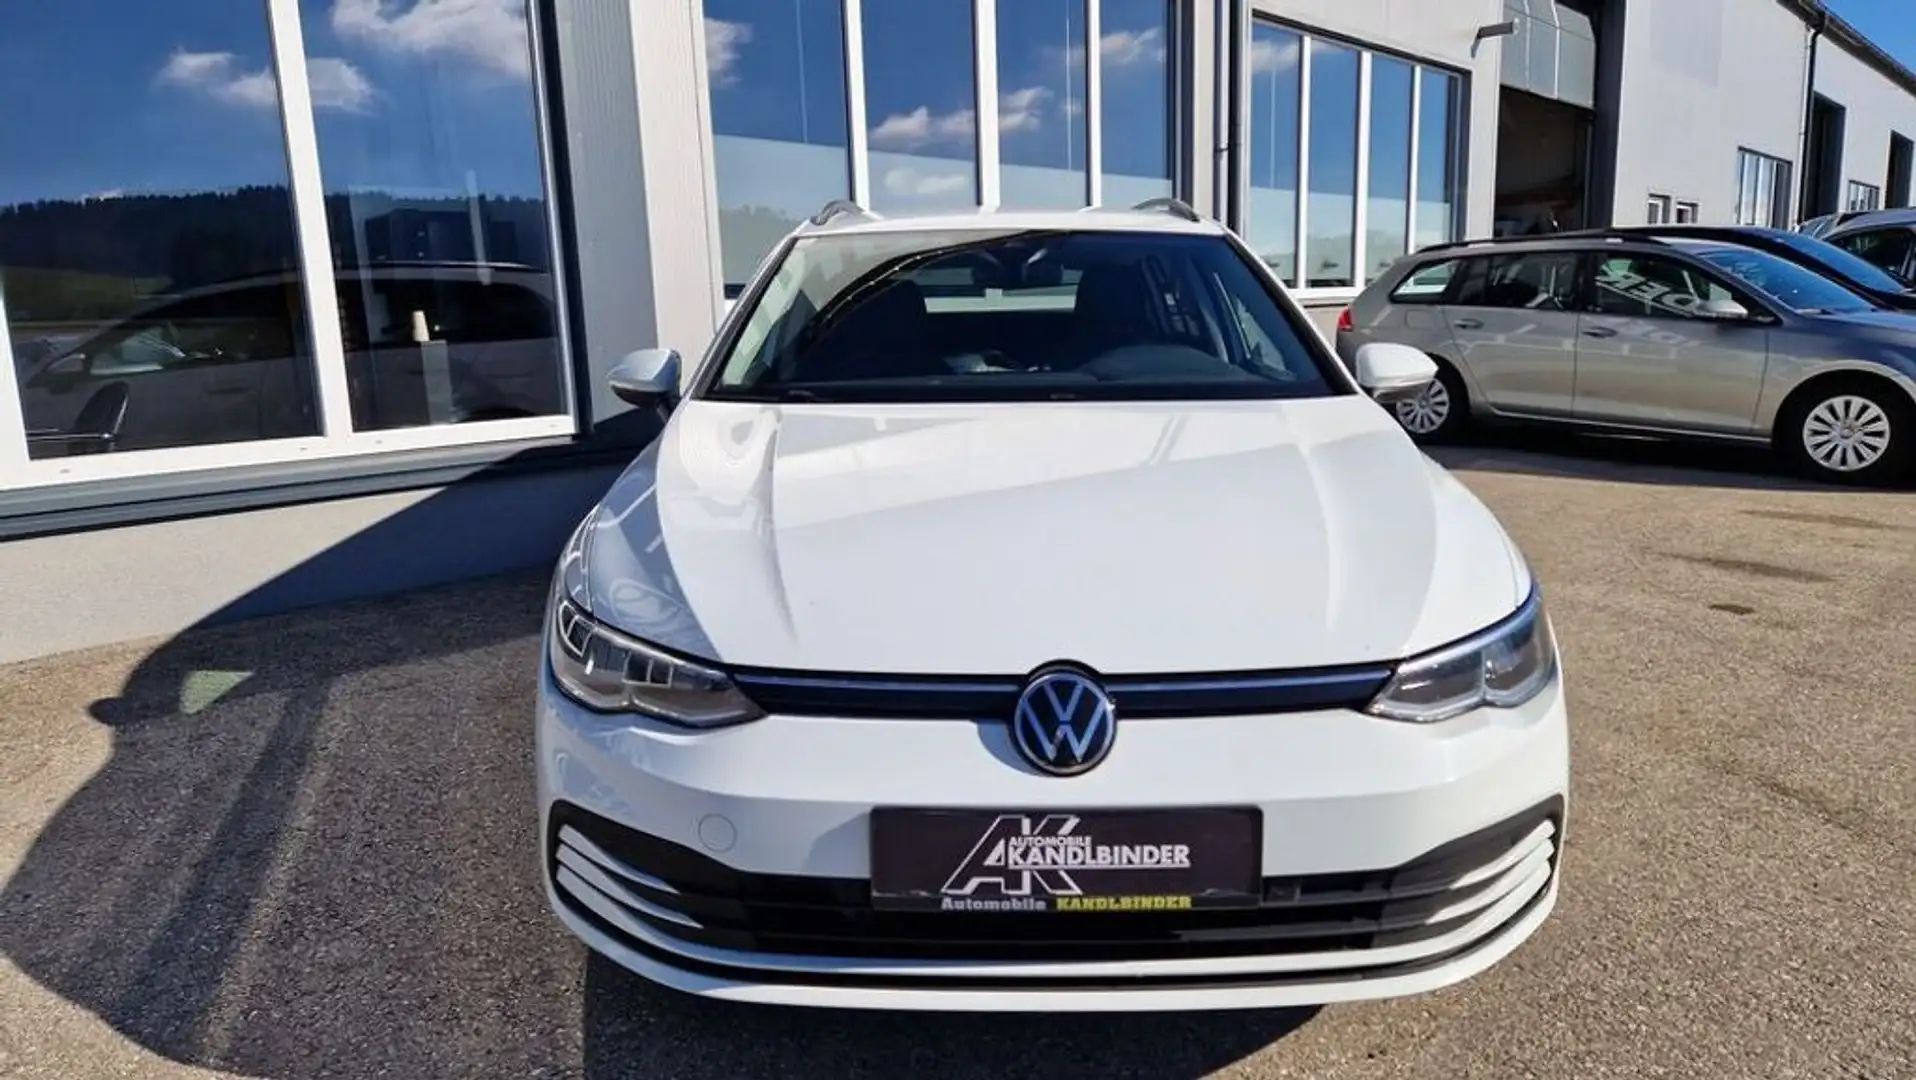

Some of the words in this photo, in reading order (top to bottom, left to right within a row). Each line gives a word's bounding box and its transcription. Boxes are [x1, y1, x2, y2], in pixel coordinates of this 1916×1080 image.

[1019, 676, 1109, 767] VW
[1008, 836, 1092, 848] AUTOMOBILE
[1008, 844, 1190, 867] KANDLBINDER
[941, 897, 1047, 910] Automobile
[1056, 896, 1192, 910] KANDLBINDER
